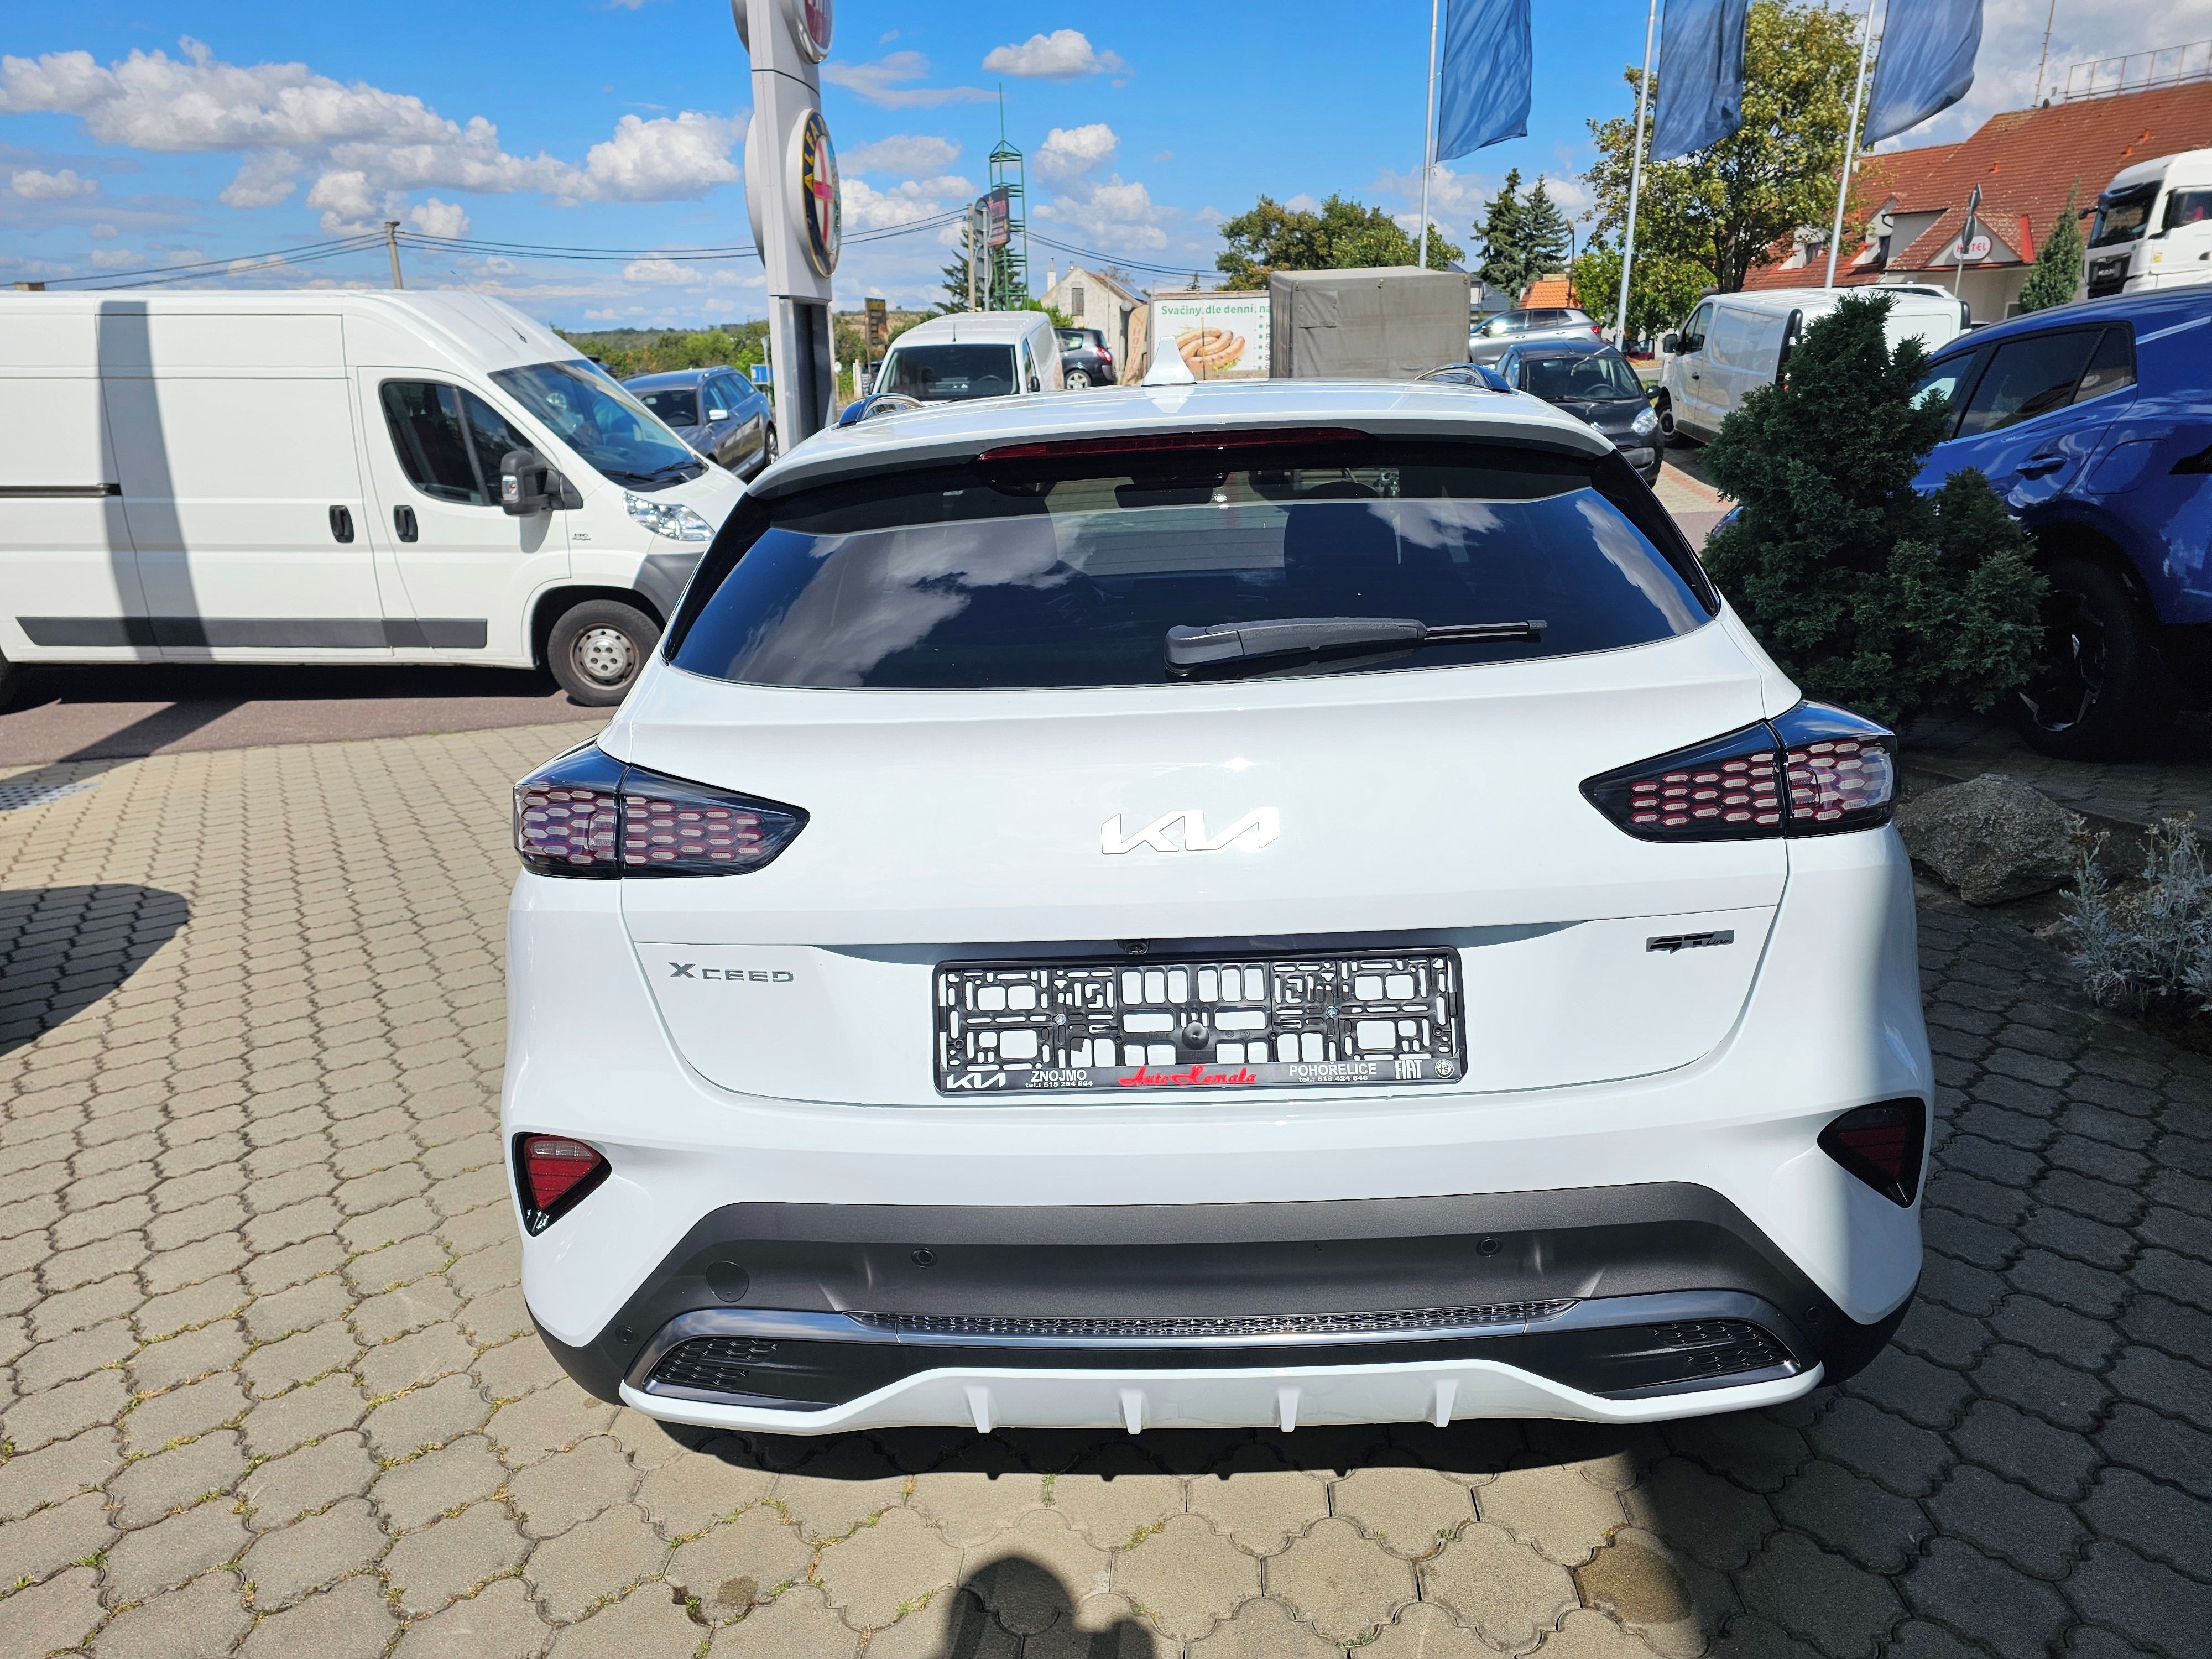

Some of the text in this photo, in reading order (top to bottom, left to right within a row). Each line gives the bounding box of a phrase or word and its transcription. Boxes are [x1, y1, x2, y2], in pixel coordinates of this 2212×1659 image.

[1956, 242, 1986, 253] HTEL
[1161, 305, 1201, 317] Svačiny
[1206, 305, 1221, 314] dle
[1224, 304, 1254, 314] denní
[1101, 806, 1280, 855] KIA
[1031, 1069, 1087, 1082] ZNOJMO
[1118, 1064, 1256, 1087] Auto Hemala
[1289, 1061, 1377, 1077] POHOŘELICE
[1395, 1060, 1422, 1079] FIAT
[946, 1072, 1006, 1089] KIA
